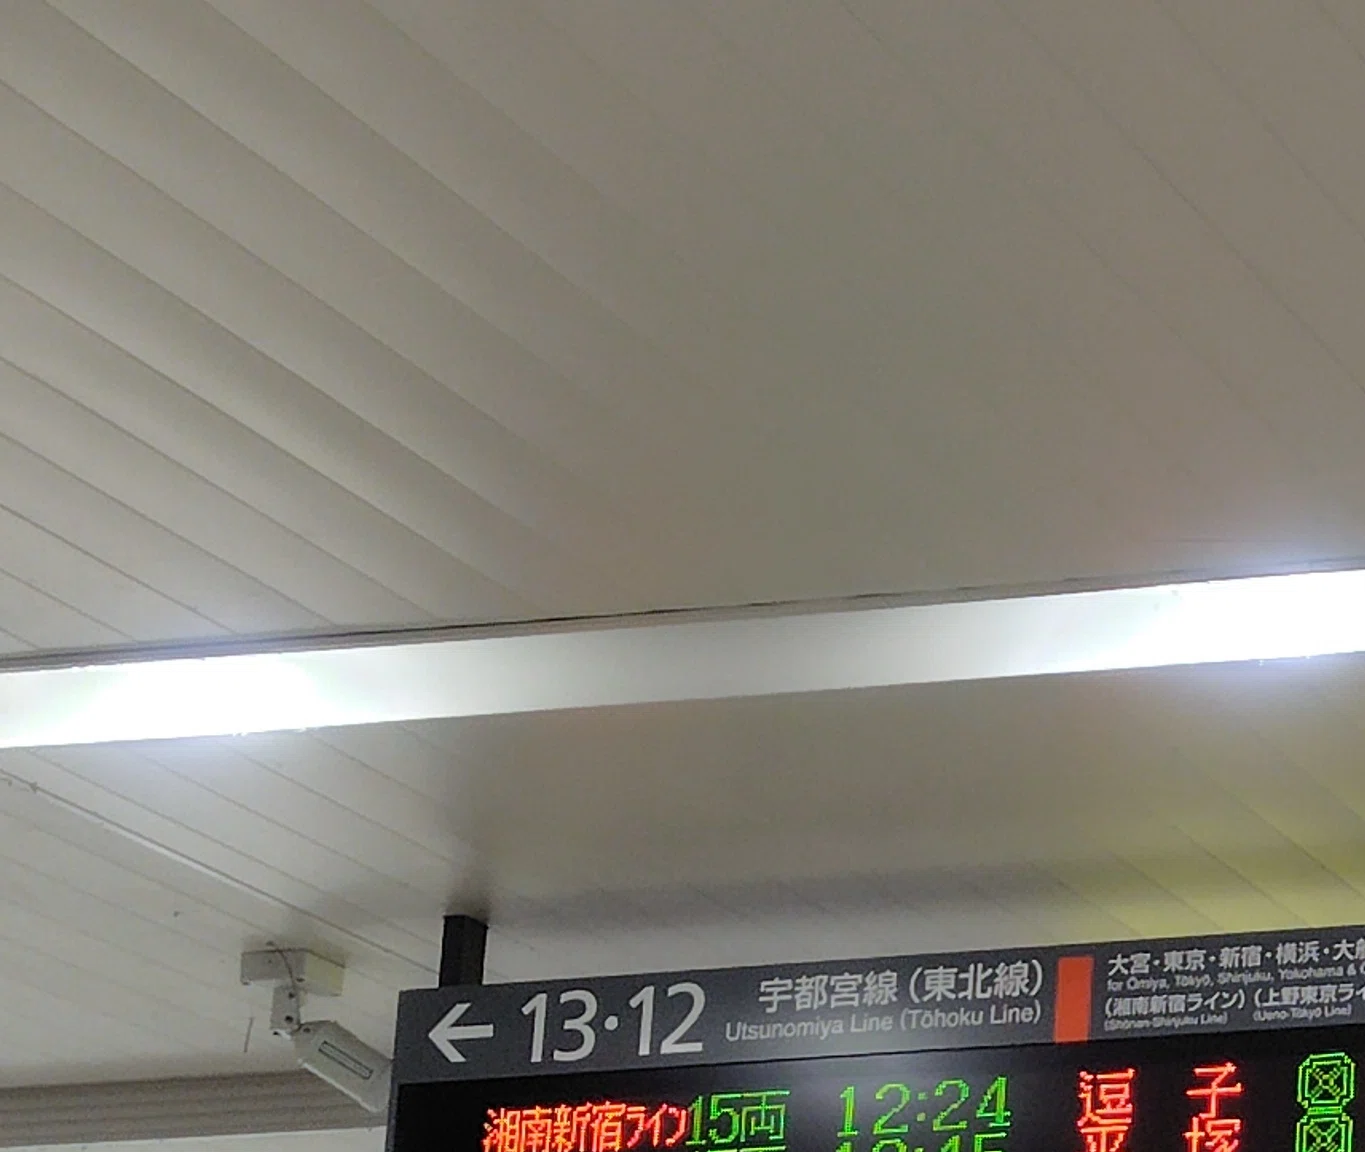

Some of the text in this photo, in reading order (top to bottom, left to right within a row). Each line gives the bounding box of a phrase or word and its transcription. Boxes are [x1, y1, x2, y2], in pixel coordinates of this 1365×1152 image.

[1107, 979, 1124, 992] for
[1279, 966, 1344, 981] Yokohama
[1347, 965, 1357, 977] &
[725, 1002, 1041, 1043] Utsunomiya Line (Tōhoku Line)
[1200, 1010, 1229, 1025] Line)
[1325, 1003, 1352, 1017] Line)
[838, 1075, 1012, 1138] 12:24
